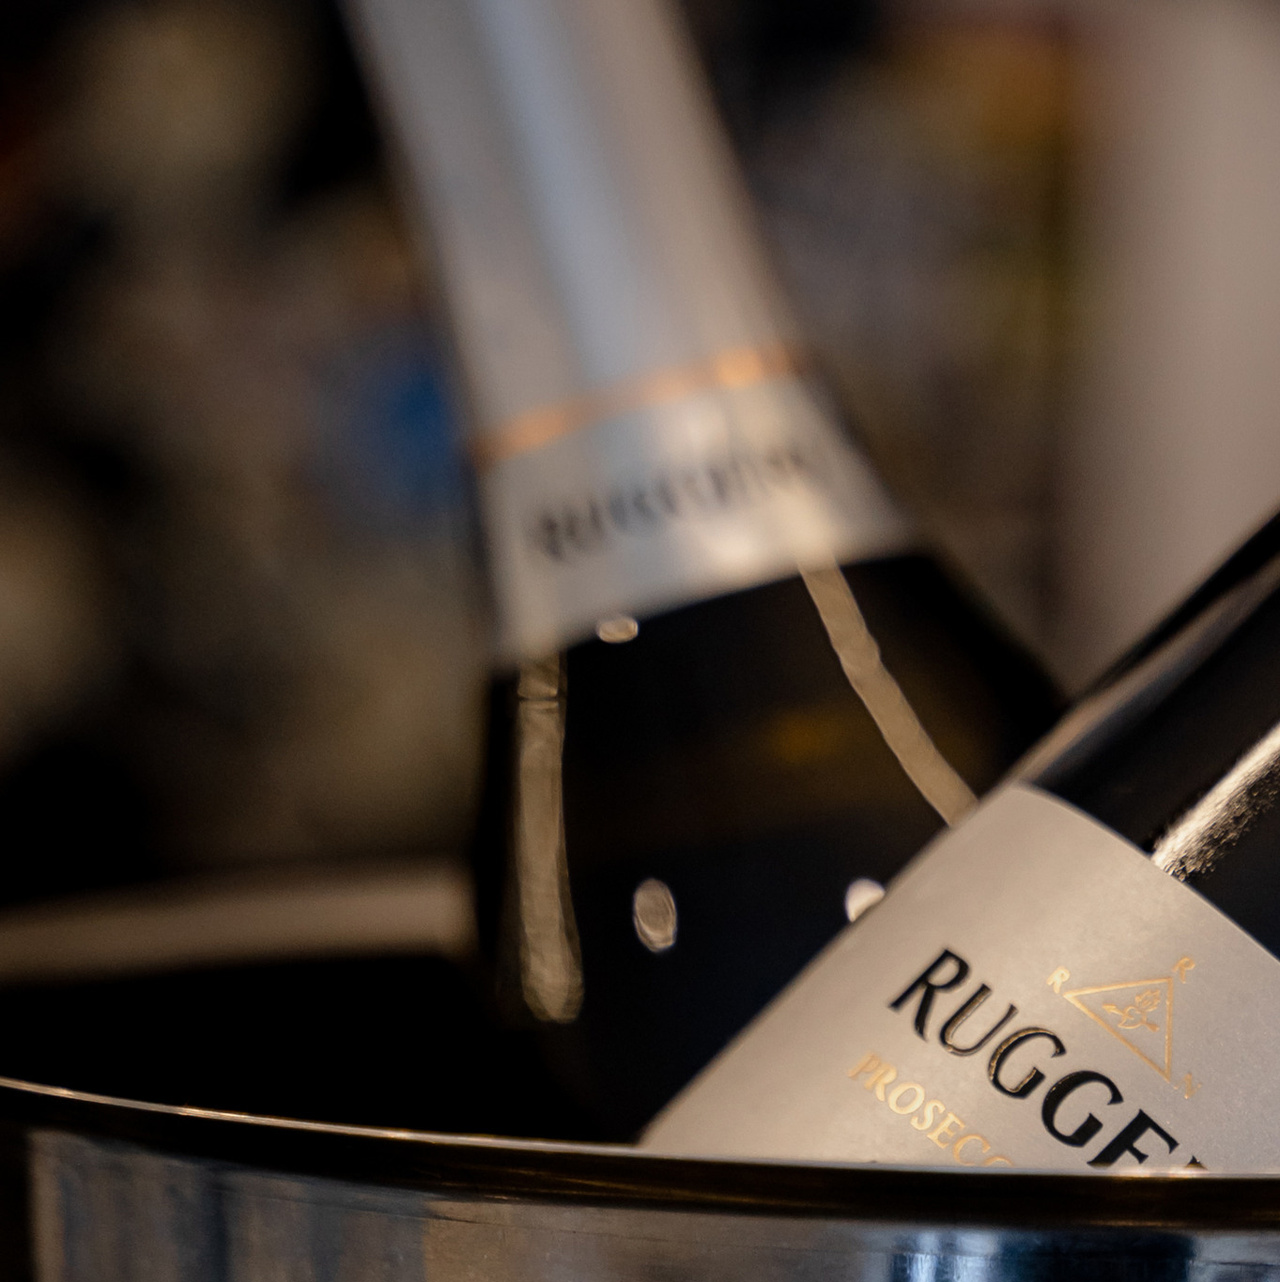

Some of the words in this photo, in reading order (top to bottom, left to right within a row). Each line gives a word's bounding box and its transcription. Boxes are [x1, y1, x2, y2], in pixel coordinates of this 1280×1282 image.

[1046, 966, 1071, 994] R
[1172, 956, 1196, 984] R
[888, 949, 1207, 1169] RUGGE
